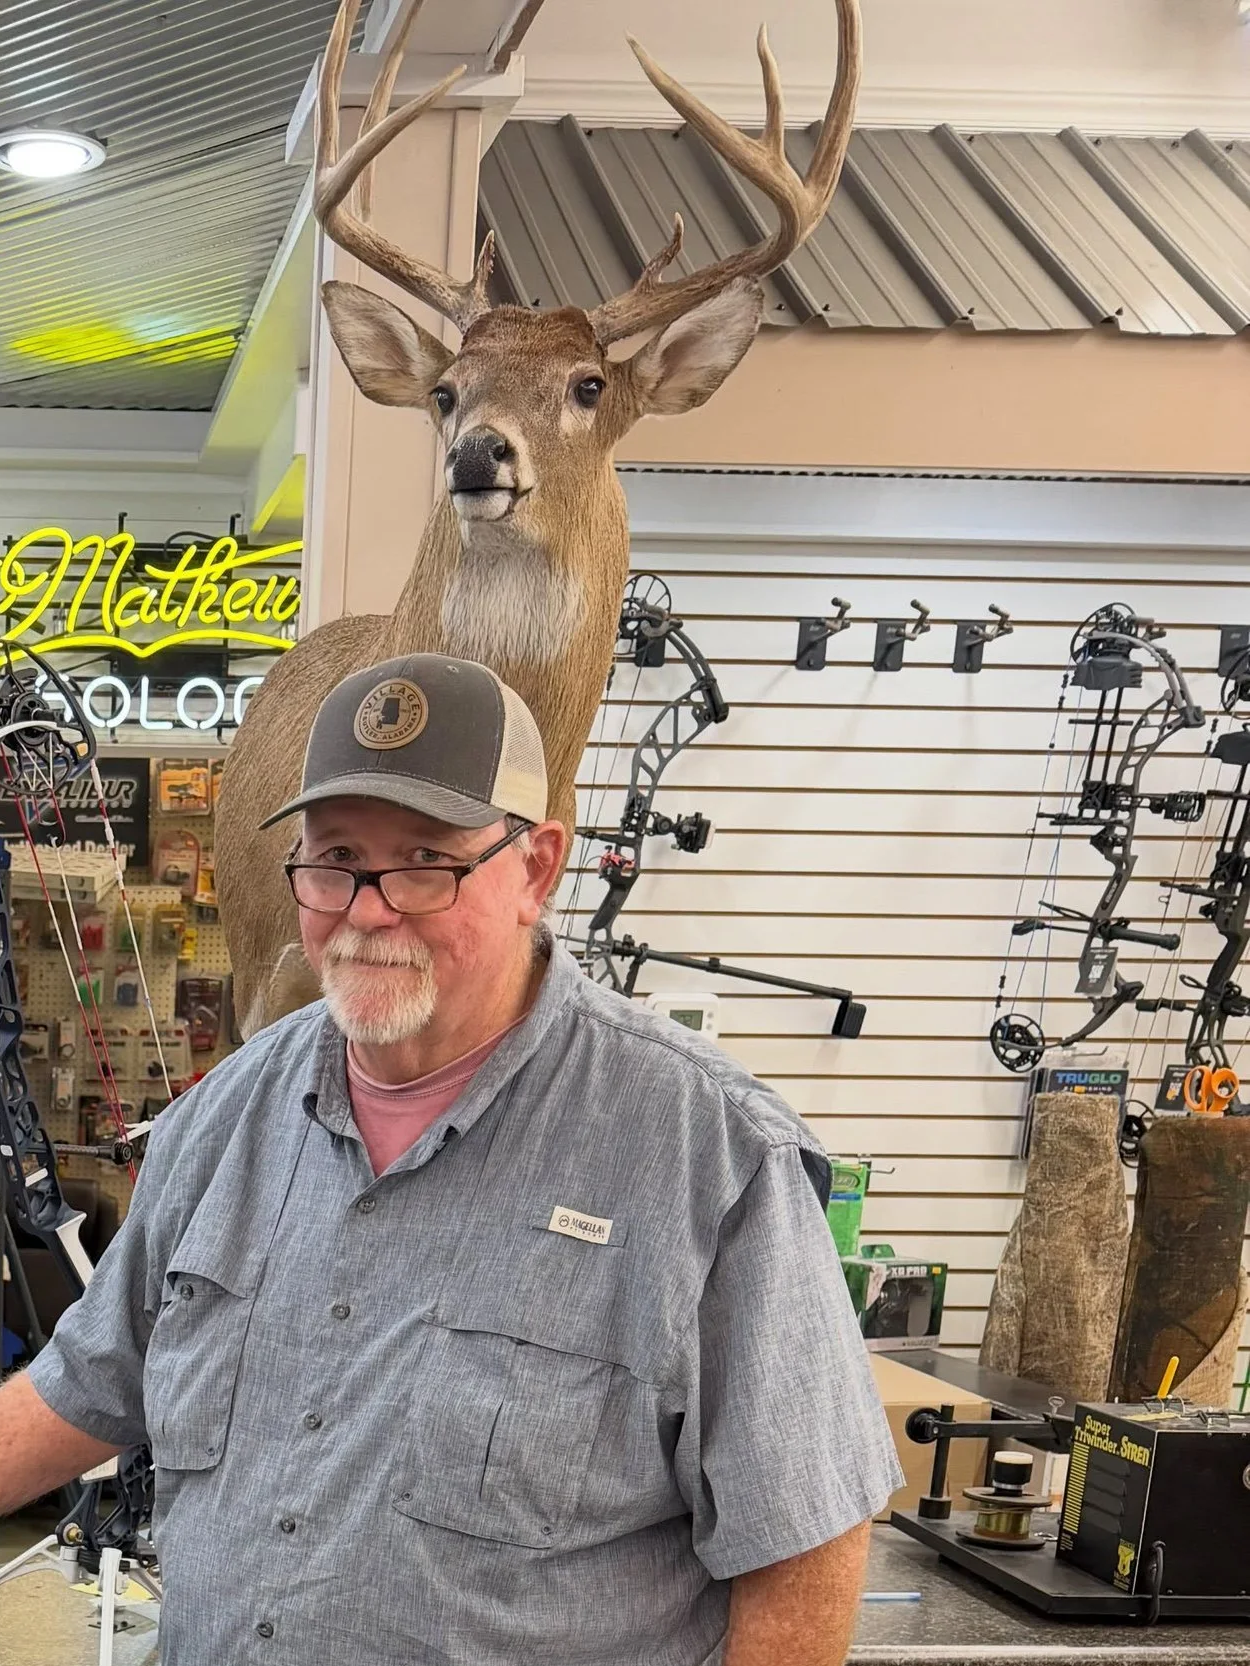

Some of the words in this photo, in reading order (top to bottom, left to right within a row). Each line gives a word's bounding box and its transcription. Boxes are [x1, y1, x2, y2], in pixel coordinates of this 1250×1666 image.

[365, 686, 420, 711] VILLAGE
[1056, 1072, 1121, 1085] TRUGLO
[1085, 1415, 1111, 1436] Super
[1075, 1425, 1117, 1454] Triwinder
